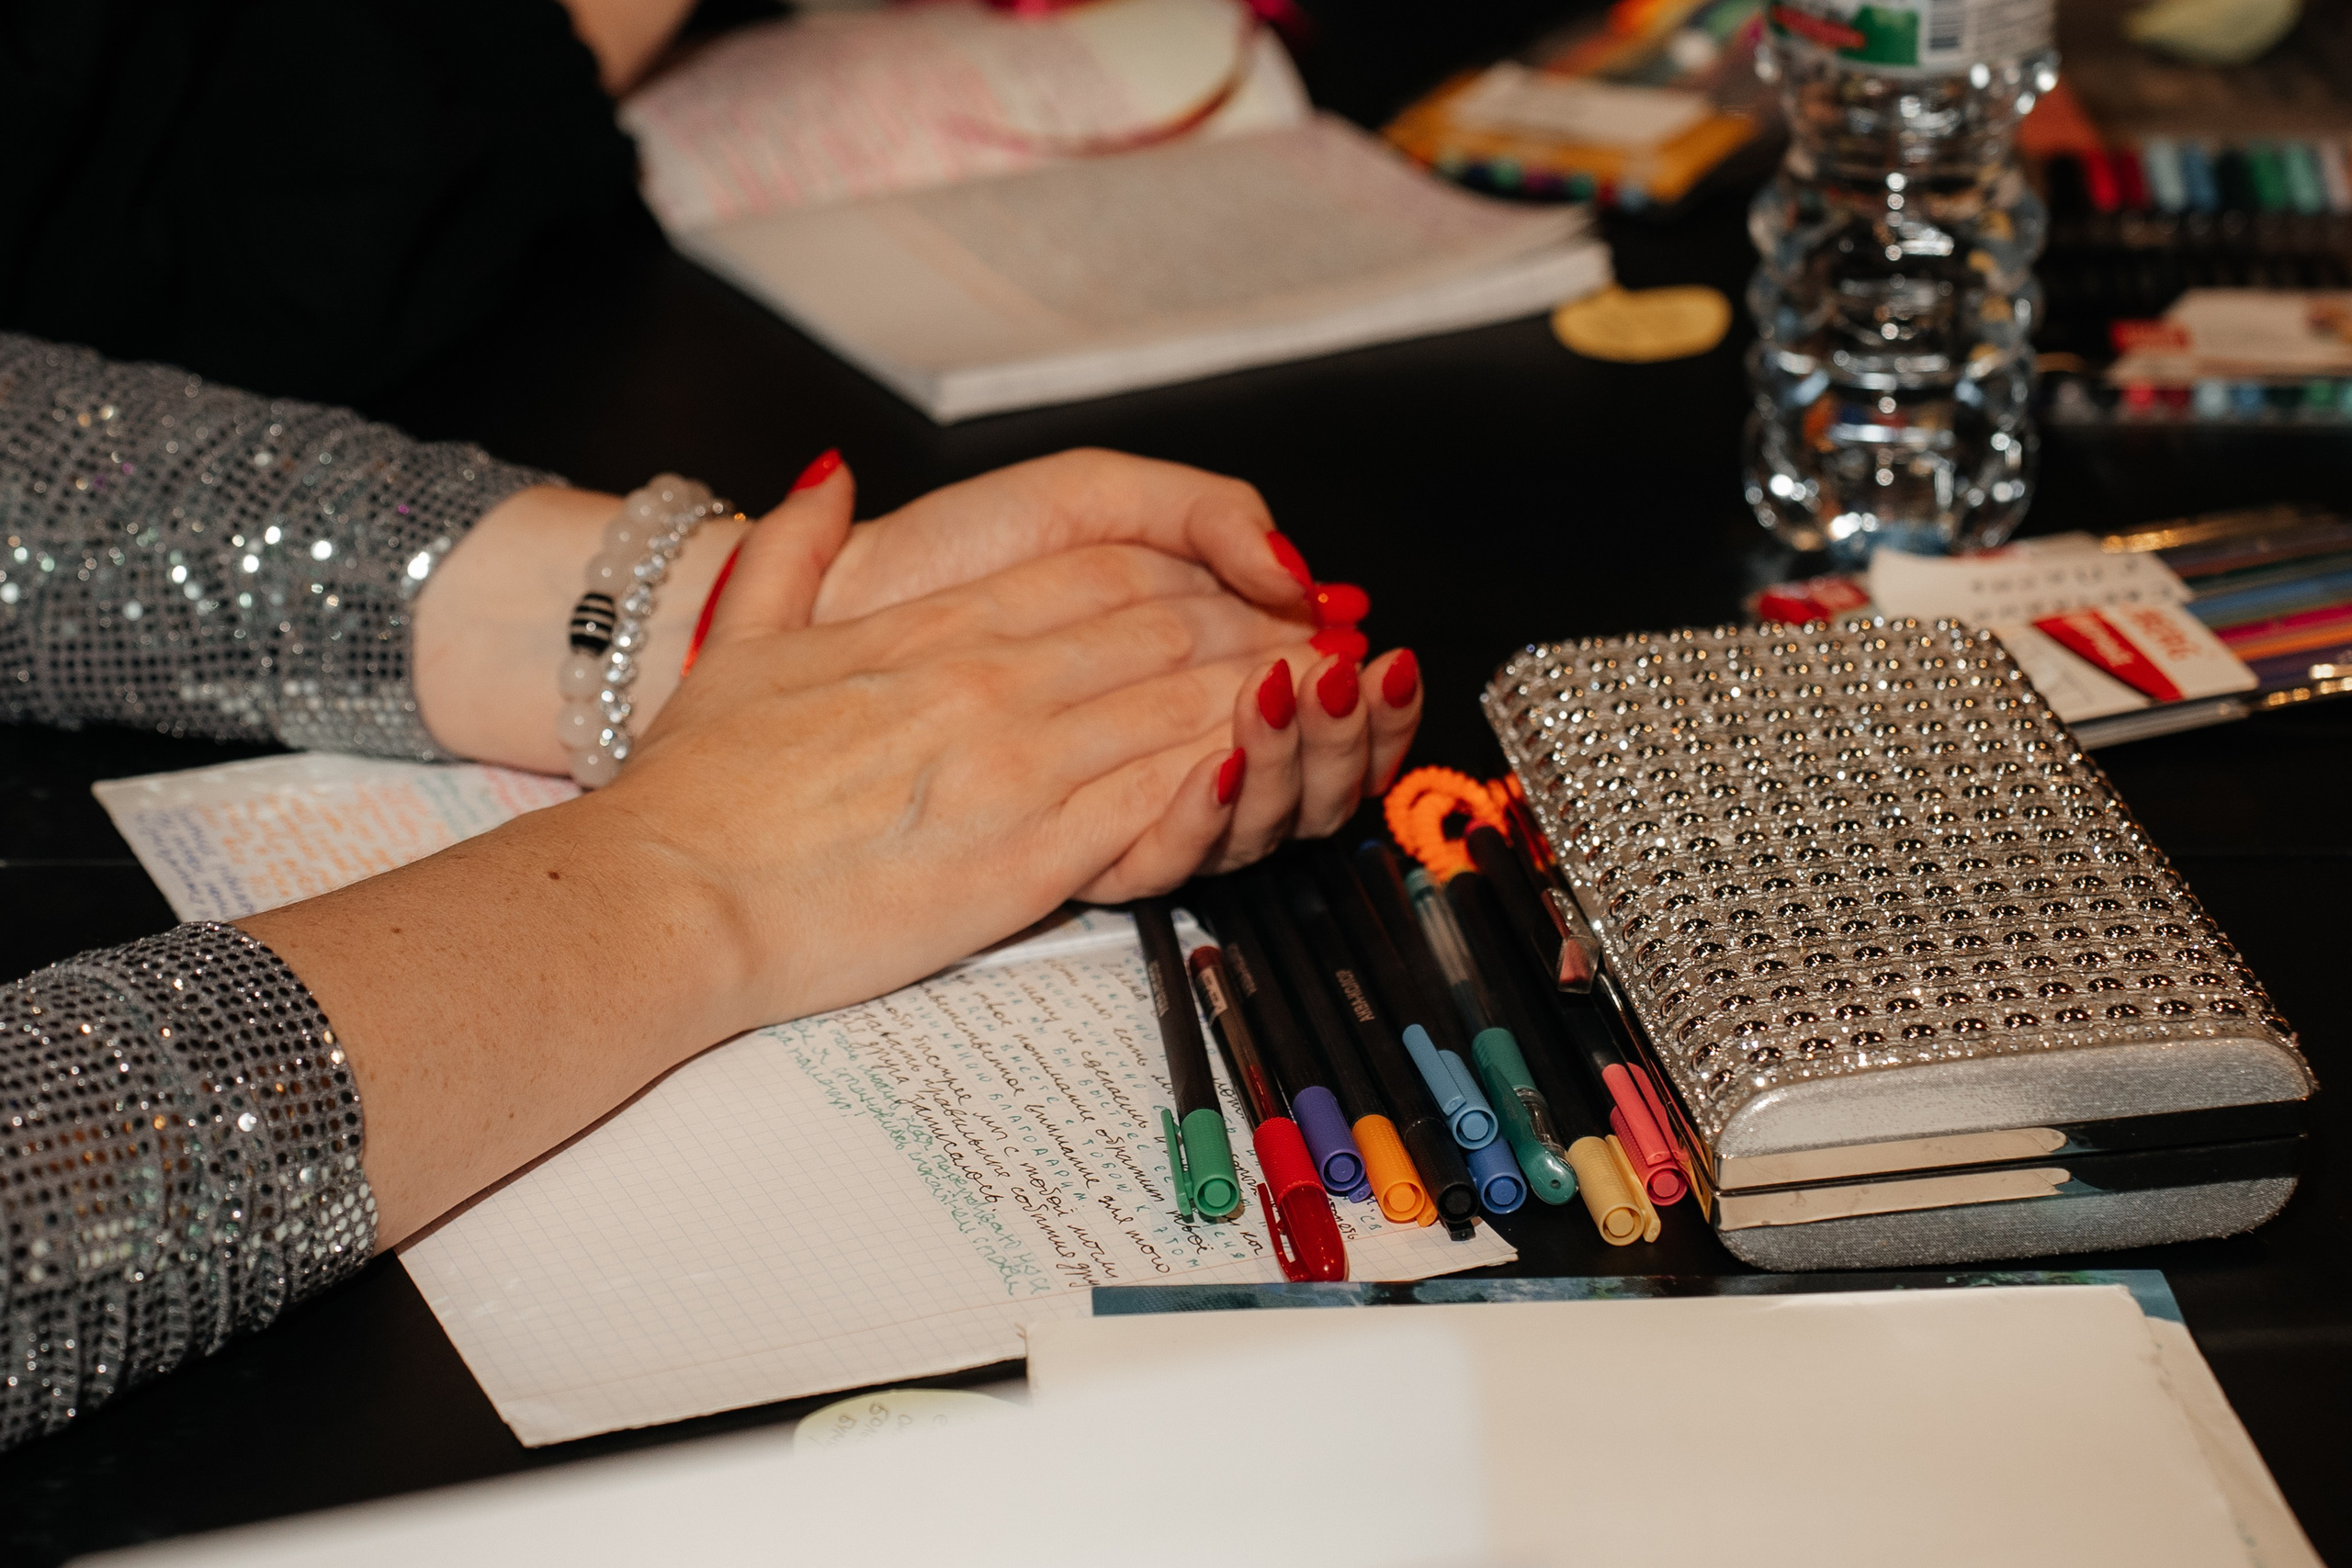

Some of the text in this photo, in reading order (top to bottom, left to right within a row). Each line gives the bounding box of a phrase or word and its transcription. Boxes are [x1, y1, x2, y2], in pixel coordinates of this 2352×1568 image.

[908, 1034, 972, 1106] быстрее
[1019, 1161, 1074, 1217] тобой
[1010, 1033, 1095, 1122] понимание
[1094, 1128, 1165, 1202] обратит
[1165, 1203, 1214, 1255] твоё
[1080, 1050, 1148, 1129] сделаешь
[1023, 1103, 1100, 1189] внимание
[1097, 1194, 1134, 1224] для
[1134, 1203, 1150, 1213] К
